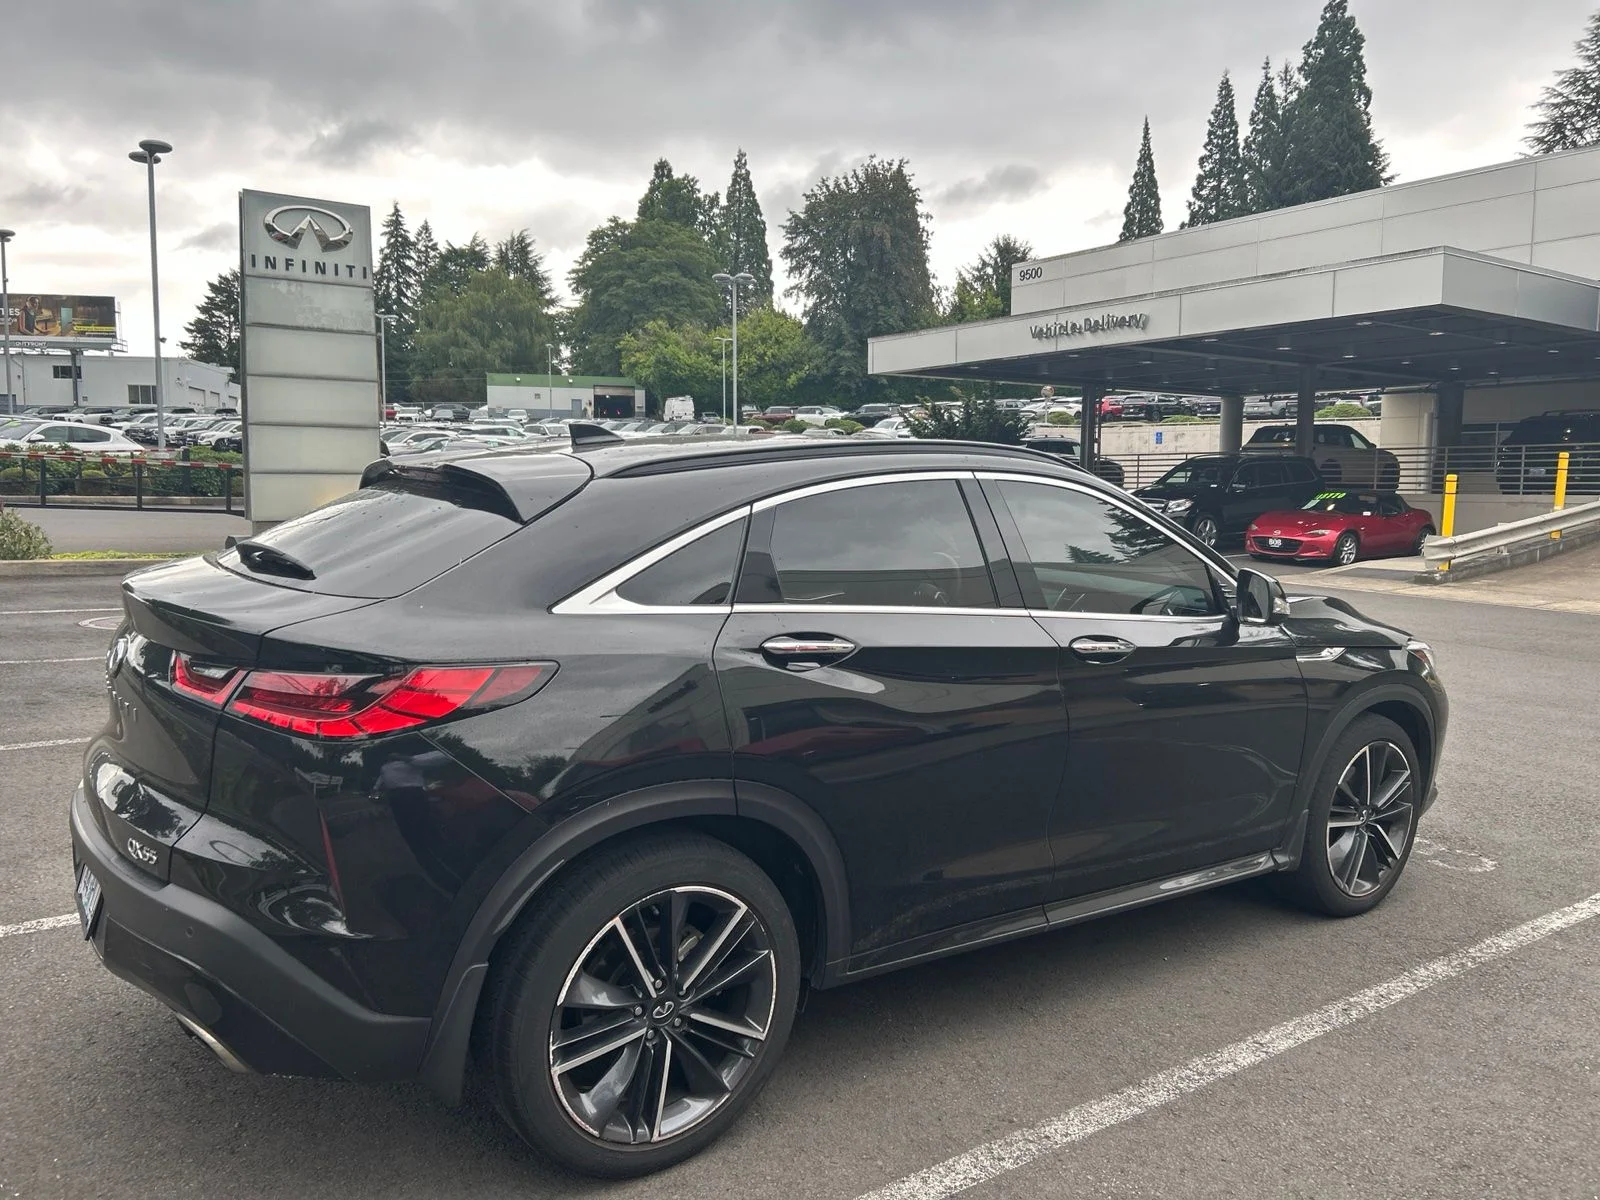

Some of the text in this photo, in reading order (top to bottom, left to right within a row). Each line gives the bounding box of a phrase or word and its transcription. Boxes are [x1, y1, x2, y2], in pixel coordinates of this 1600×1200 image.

[251, 254, 367, 279] INFINITI
[1019, 266, 1043, 281] 9500
[1030, 313, 1149, 339] Vehicle Delivery
[127, 838, 157, 865] QX55
